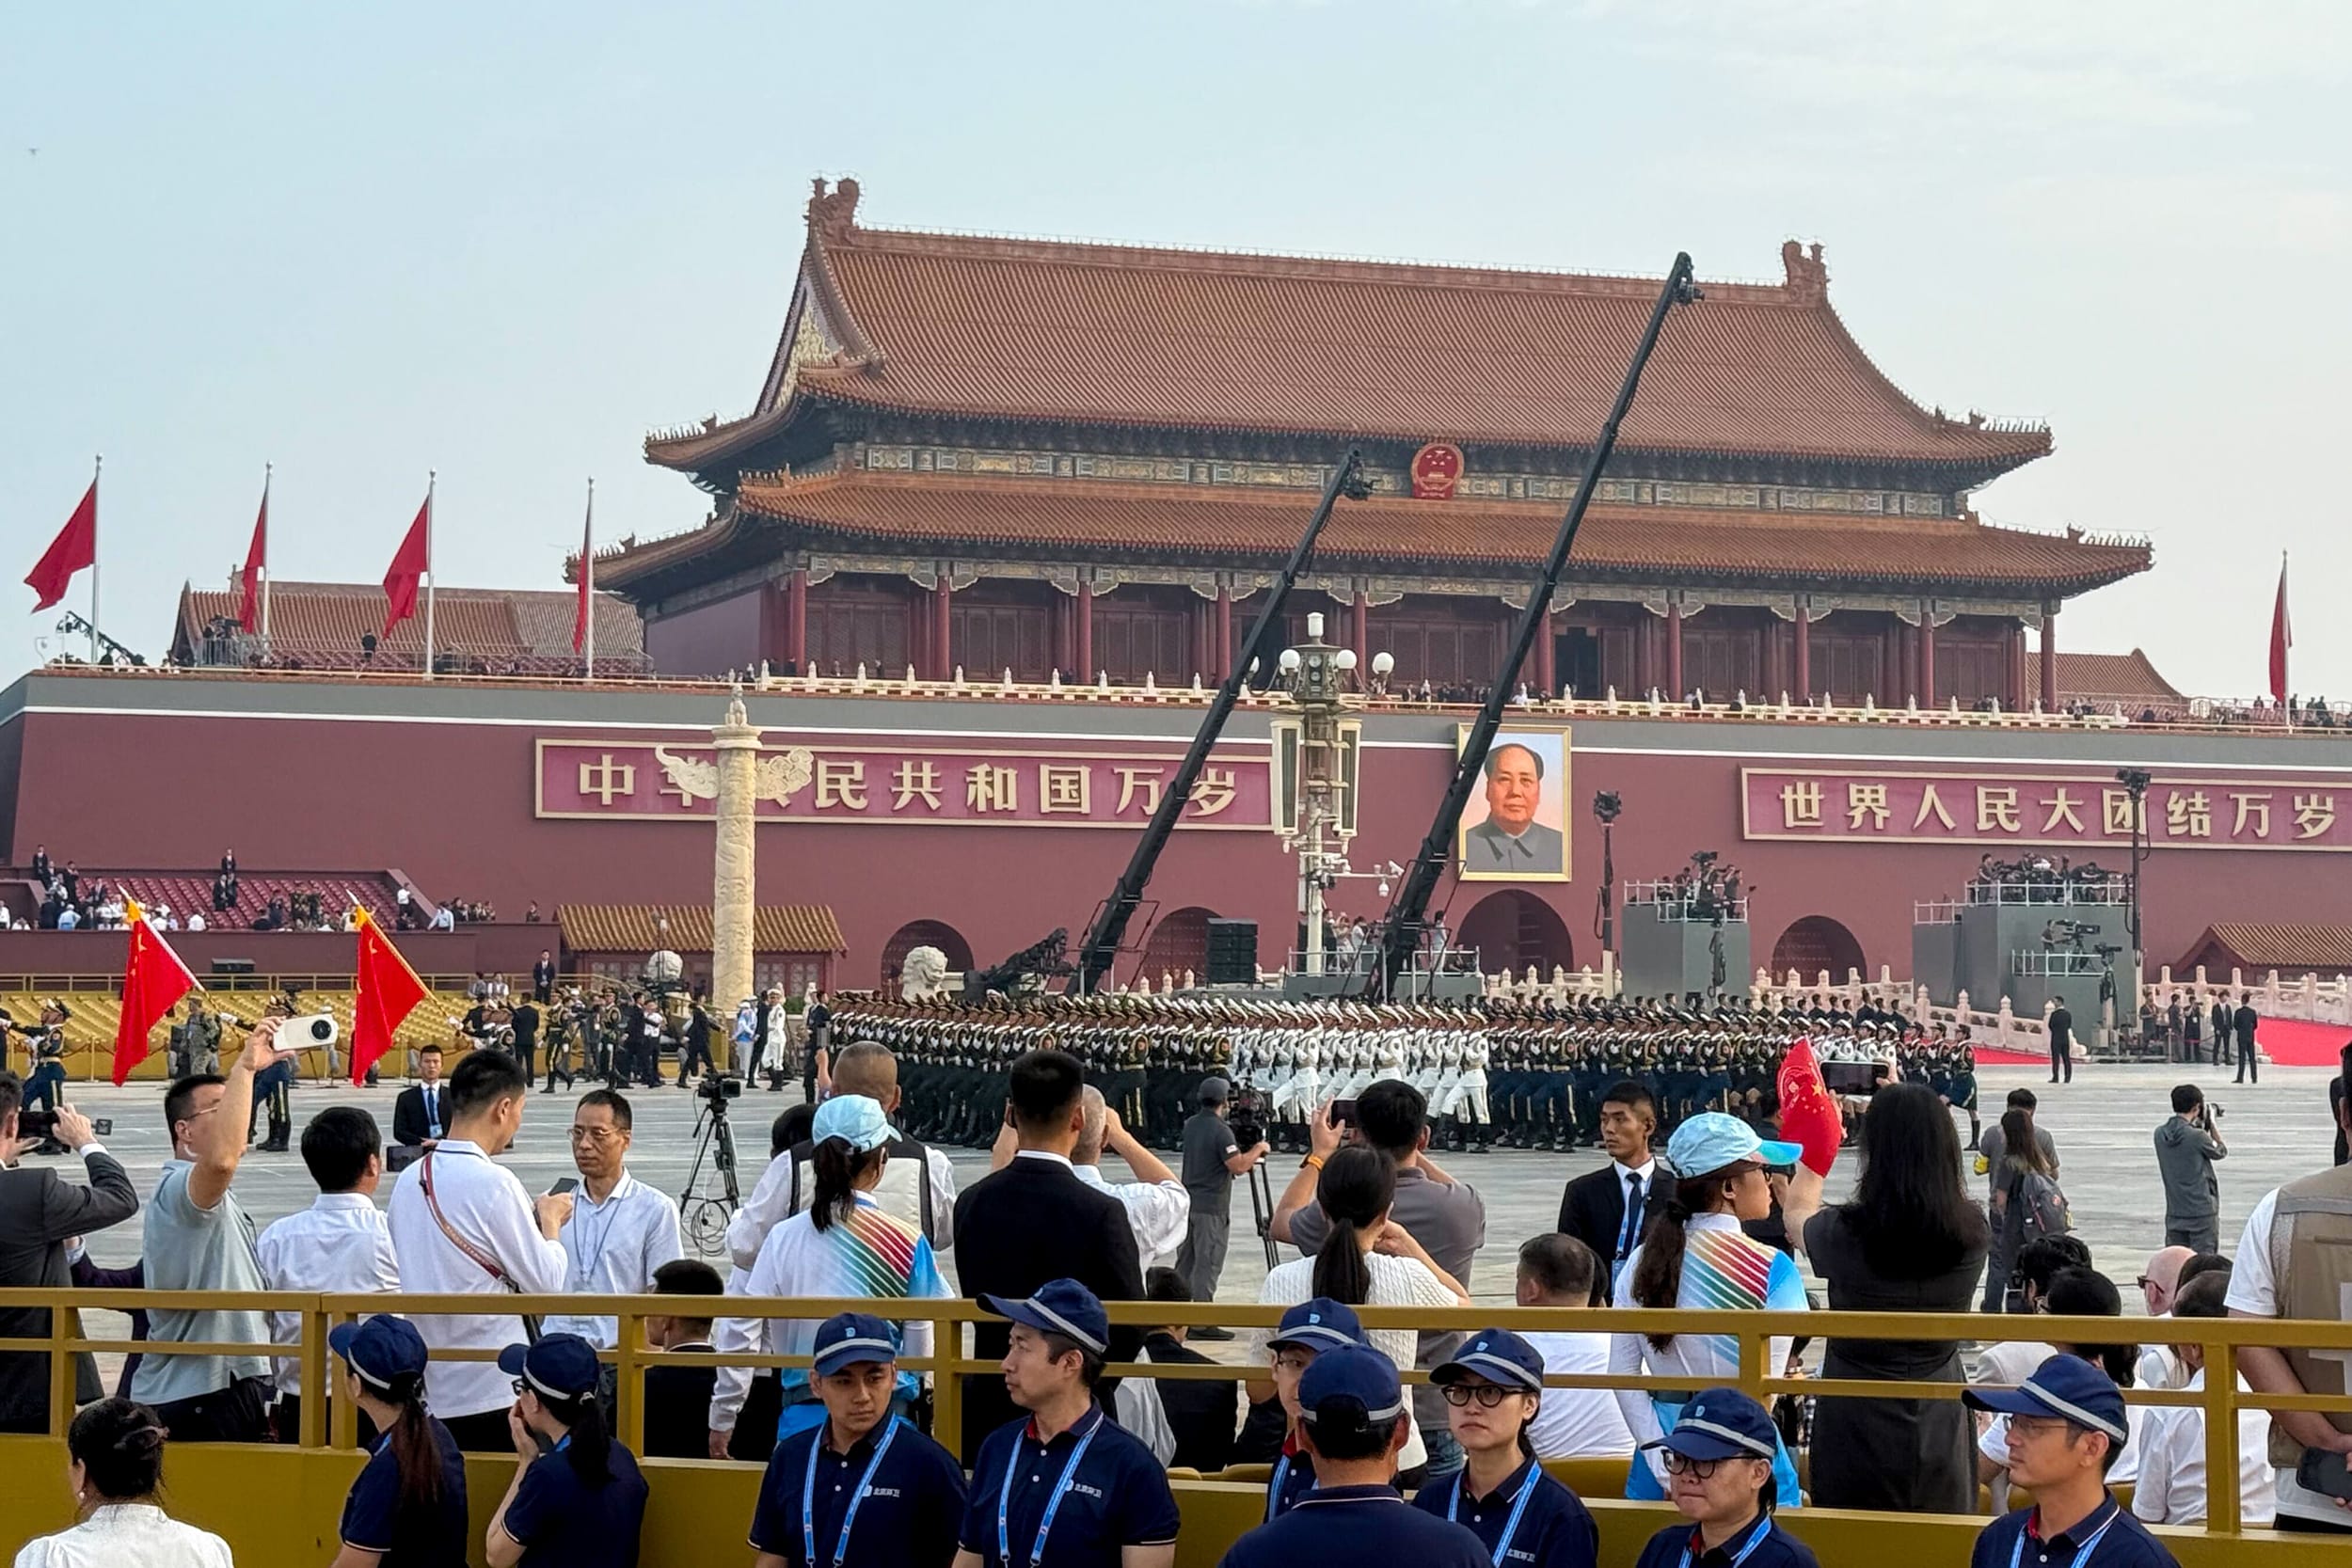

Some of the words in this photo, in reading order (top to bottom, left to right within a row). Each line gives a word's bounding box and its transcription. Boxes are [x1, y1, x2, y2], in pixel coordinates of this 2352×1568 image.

[579, 753, 1237, 817] 中民共和国万岁
[1778, 782, 2336, 840] 世界人民大团结万岁
